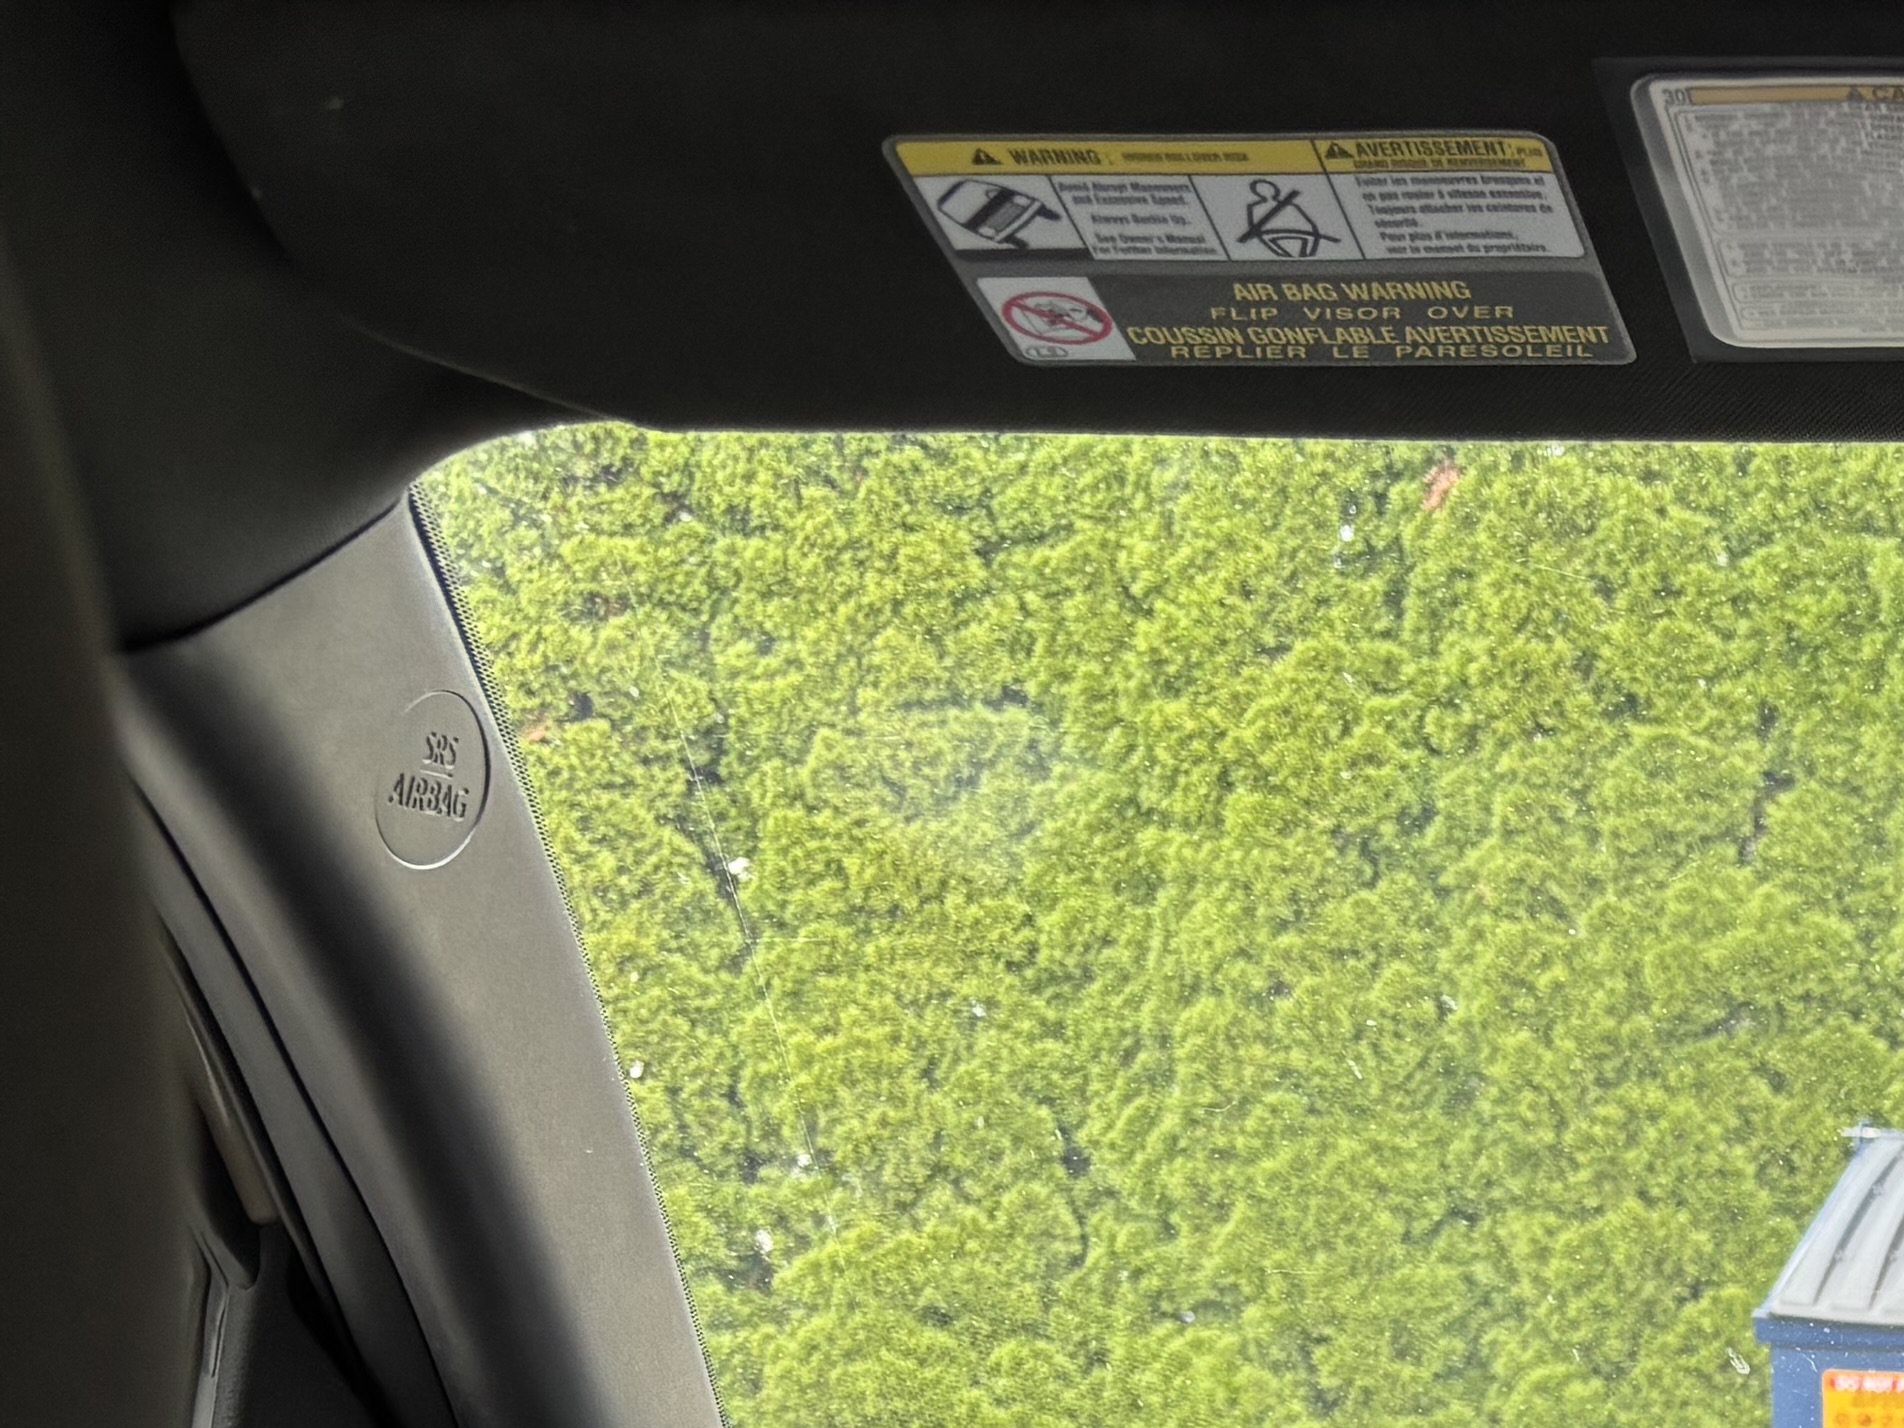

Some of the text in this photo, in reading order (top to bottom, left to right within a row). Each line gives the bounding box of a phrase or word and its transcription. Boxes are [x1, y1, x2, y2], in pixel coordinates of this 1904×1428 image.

[1233, 281, 1471, 302] AIR BAG WARNING
[1210, 305, 1514, 320] FLIP VISOR OVER
[1127, 326, 1609, 346] COUSSIN GONFLABLE AVERTISSEMENT
[1171, 345, 1591, 358] REPLIER LE PARESOLEIL
[422, 730, 460, 770] SRS
[387, 772, 470, 822] AIRBAG
